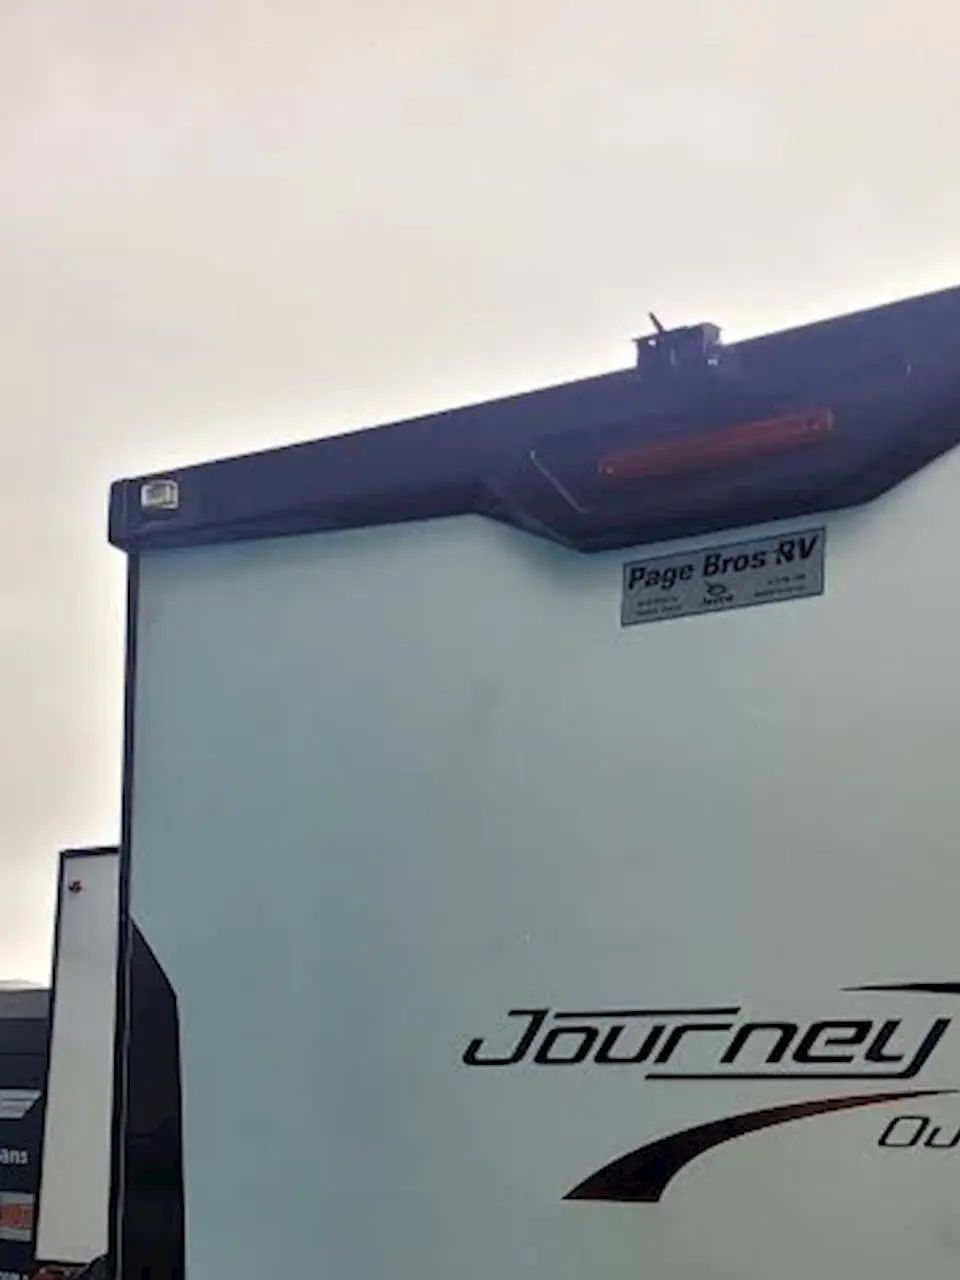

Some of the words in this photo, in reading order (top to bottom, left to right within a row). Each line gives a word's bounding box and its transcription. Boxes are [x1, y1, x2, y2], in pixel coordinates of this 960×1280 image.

[628, 564, 696, 592] Page
[702, 549, 767, 579] Bros
[775, 535, 819, 566] RV
[463, 1007, 951, 1080] Journey
